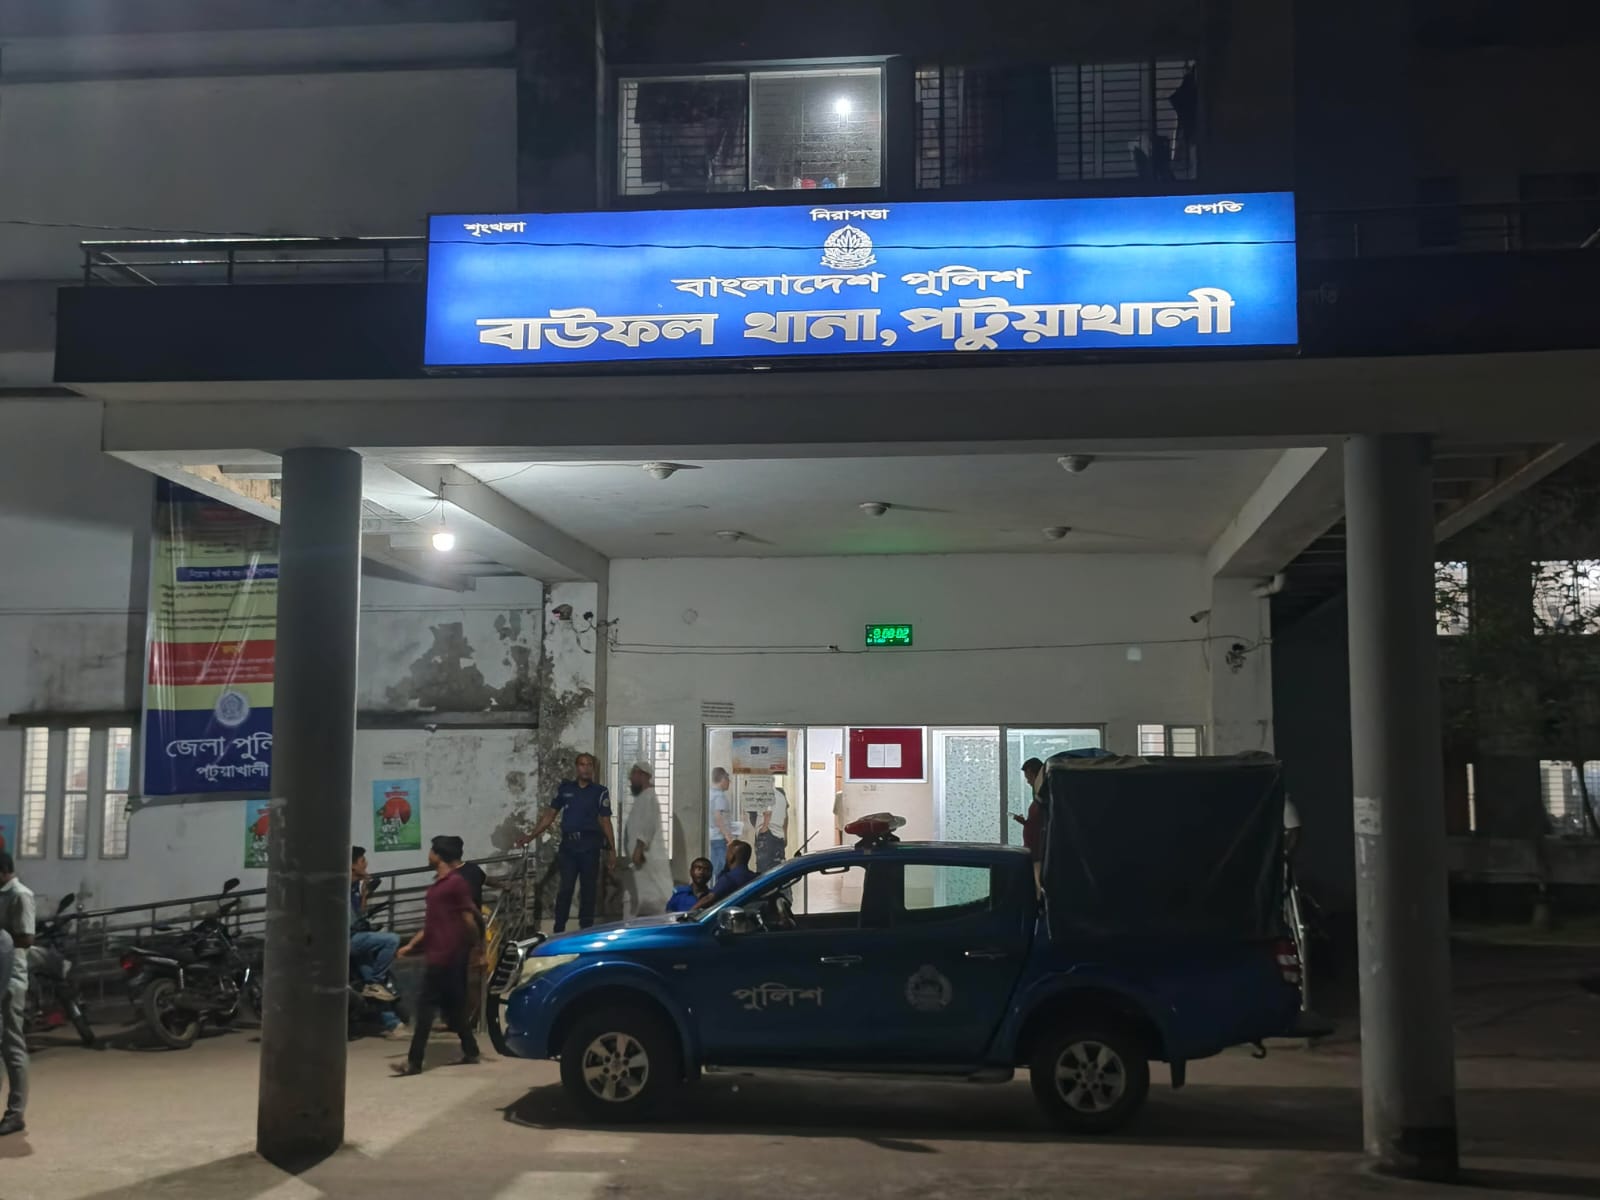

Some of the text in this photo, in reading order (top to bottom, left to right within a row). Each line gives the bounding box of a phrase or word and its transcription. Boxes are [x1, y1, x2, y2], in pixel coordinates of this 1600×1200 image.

[809, 208, 890, 221] নিরাপত্তা
[1184, 200, 1244, 215] প্রগতি
[670, 265, 1032, 298] বাংলাদেশ পুলিশ
[476, 308, 719, 350] বাউফল
[166, 732, 273, 760] জেলা পুলি
[196, 762, 269, 782] পটুয়াখালী
[732, 982, 824, 1011] পুলিশ
